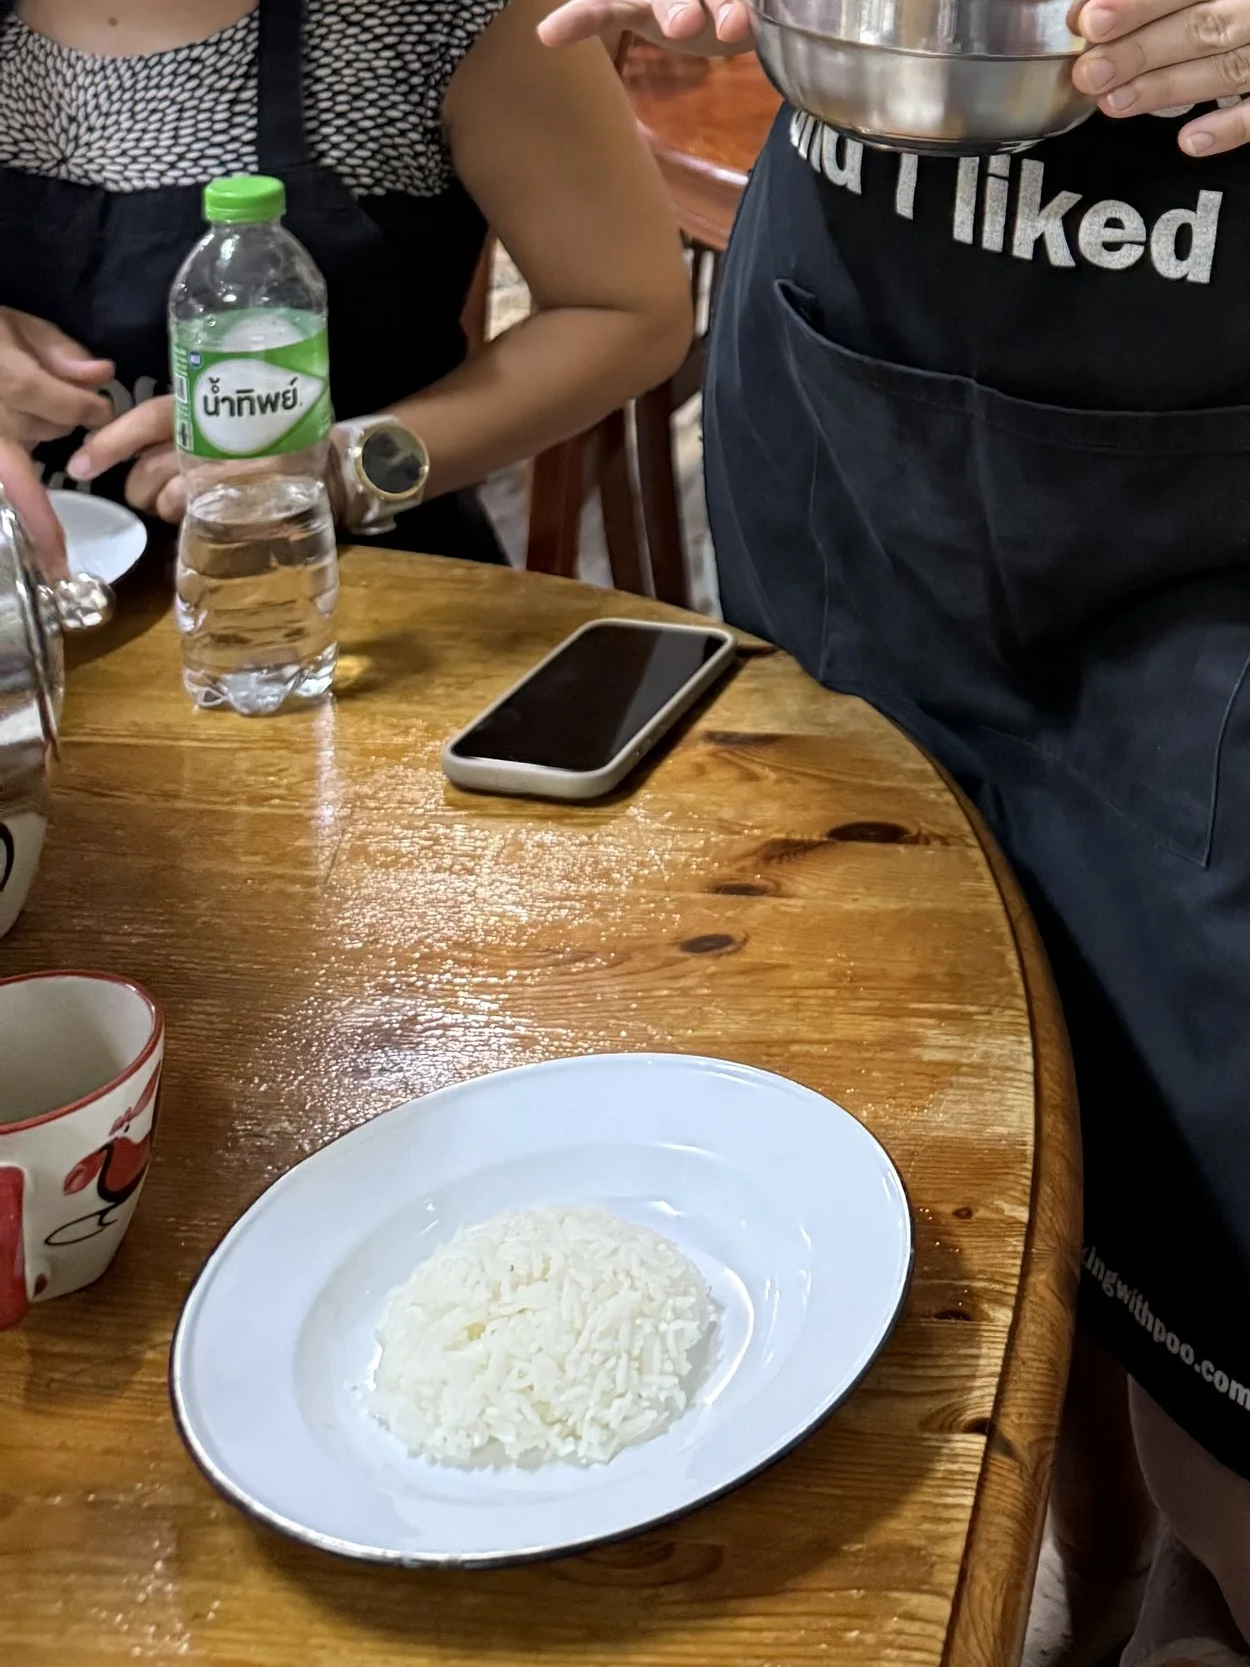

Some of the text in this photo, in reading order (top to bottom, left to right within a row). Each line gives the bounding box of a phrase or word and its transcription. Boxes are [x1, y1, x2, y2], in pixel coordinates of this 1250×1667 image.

[953, 154, 1223, 284] liked
[203, 376, 298, 417] น้ำทิพย์
